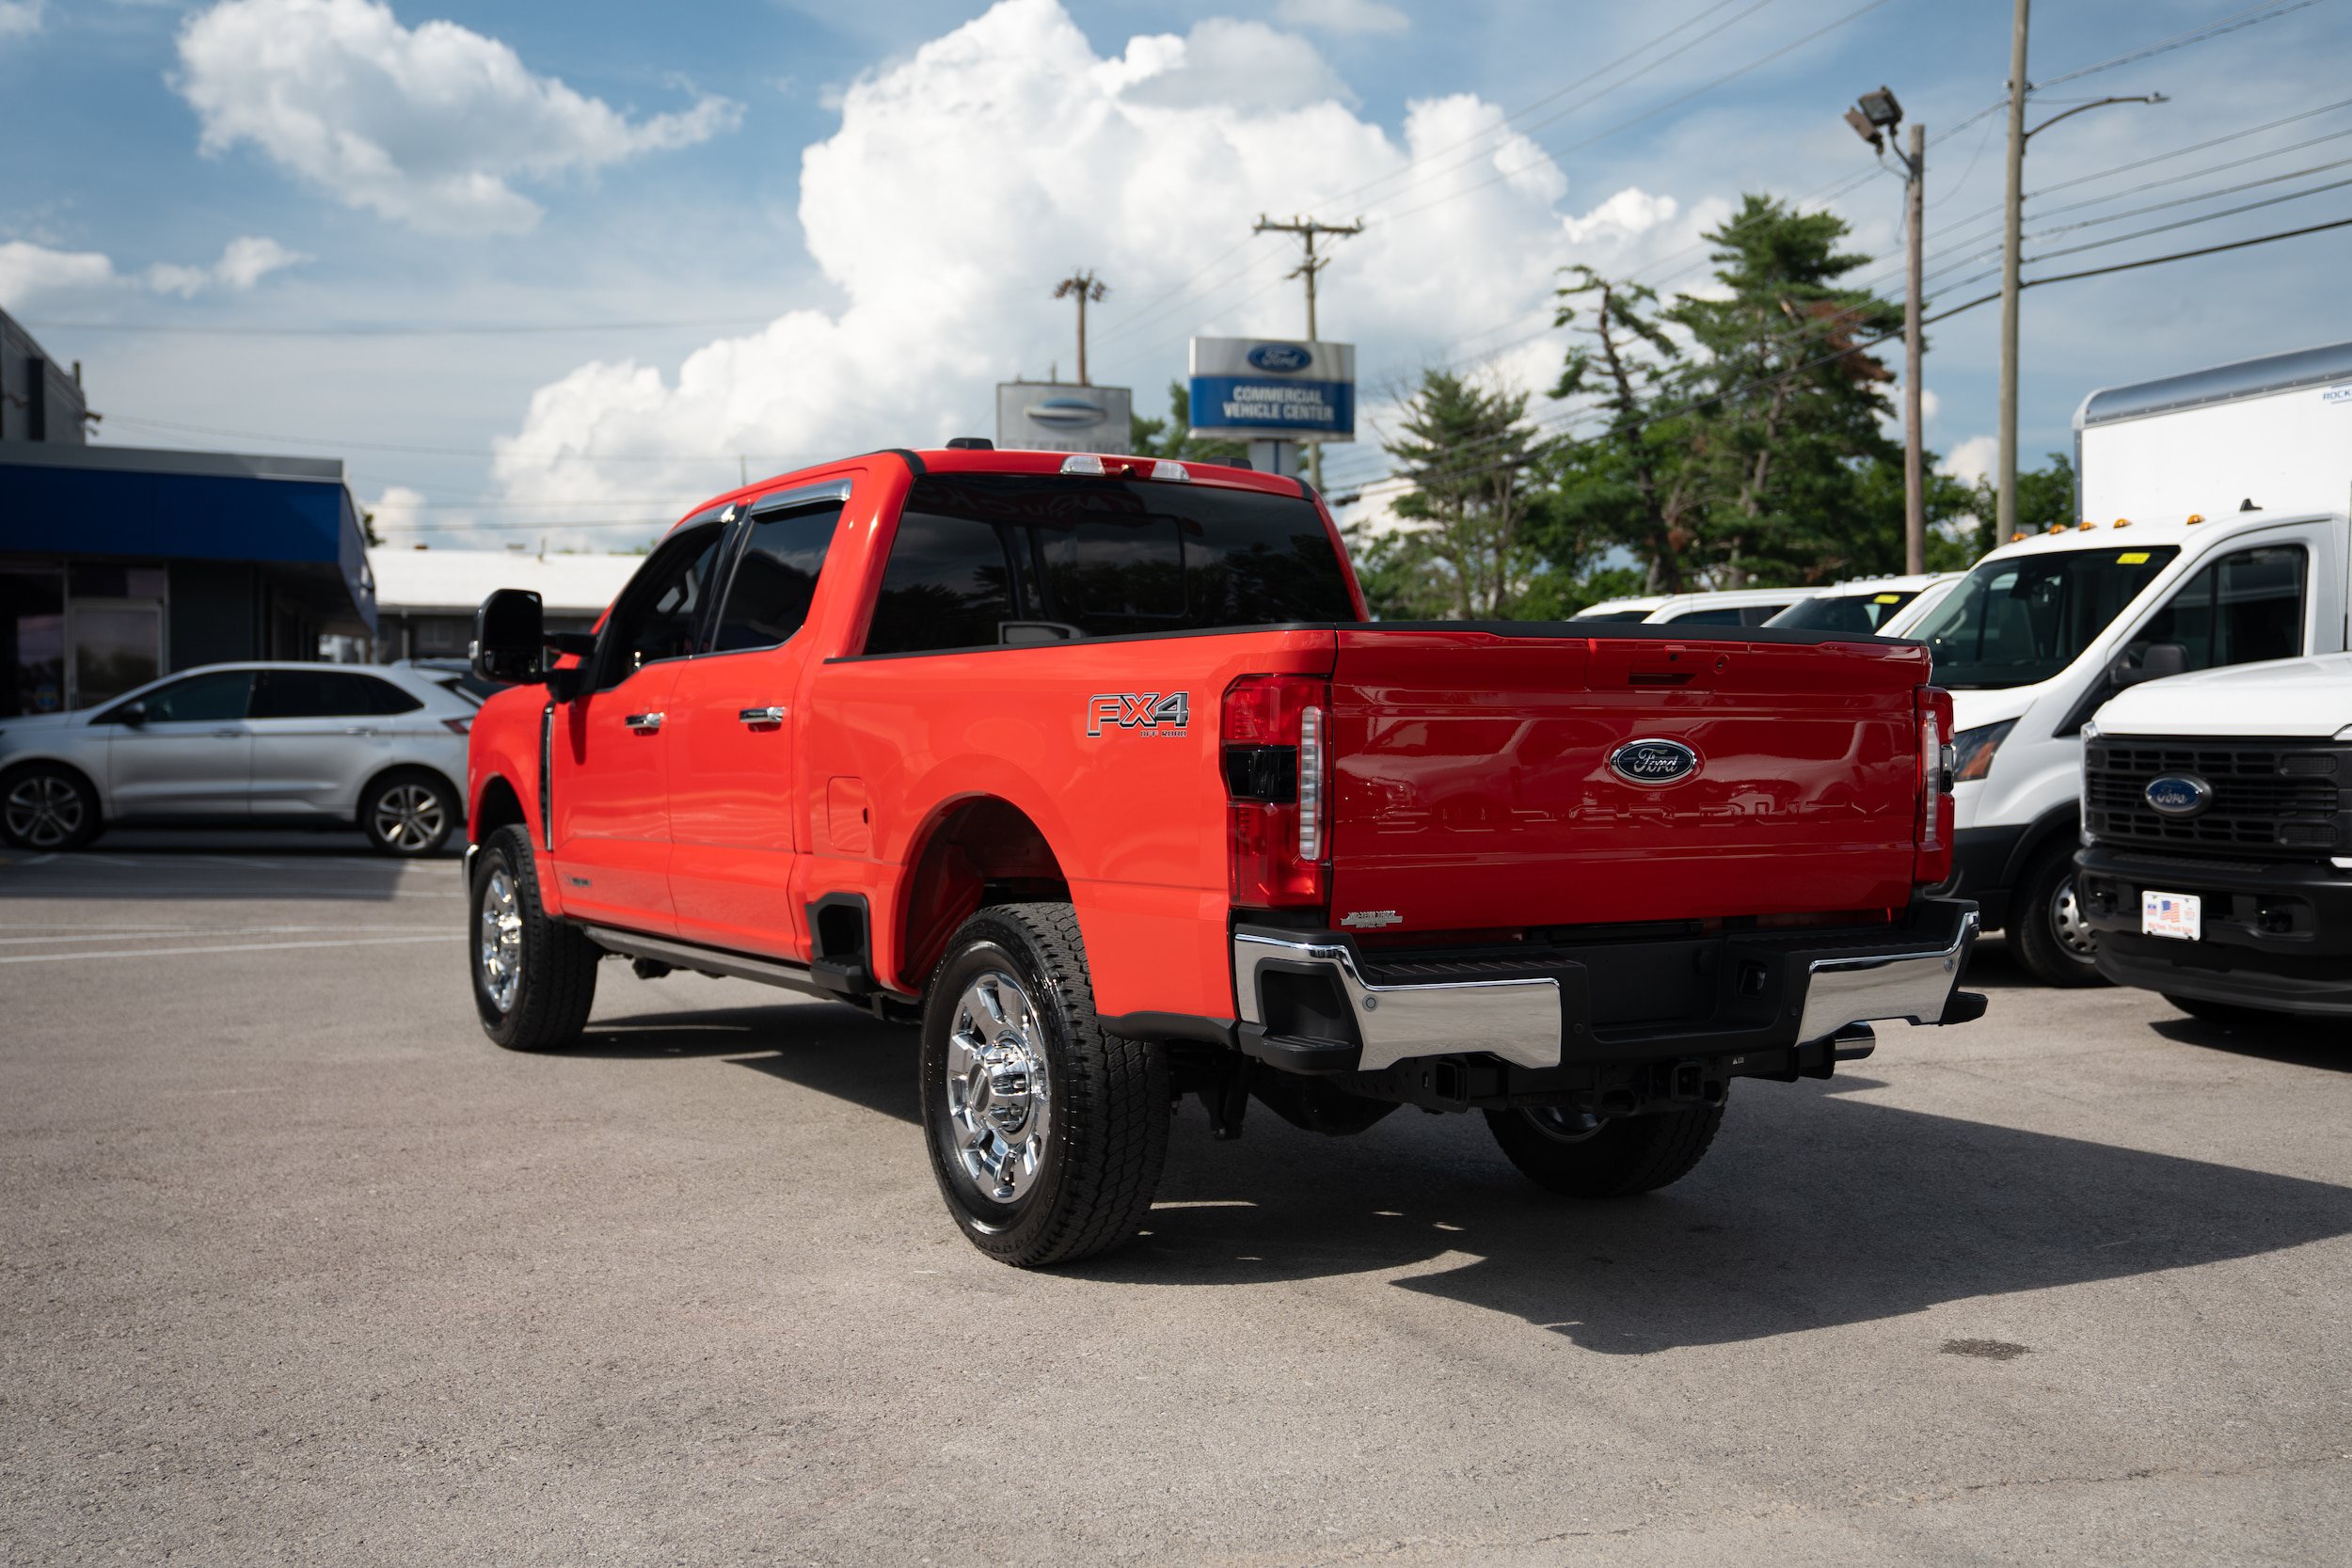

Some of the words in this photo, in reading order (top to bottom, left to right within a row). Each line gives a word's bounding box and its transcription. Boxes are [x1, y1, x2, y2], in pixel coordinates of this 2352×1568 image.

[1232, 386, 1323, 404] COMMERCIAL
[1223, 402, 1281, 419] VEHICLE
[1282, 404, 1335, 421] CENTER
[1087, 691, 1189, 737] FX4
[1161, 729, 1187, 738] ROAD
[1633, 748, 1679, 773] Ford
